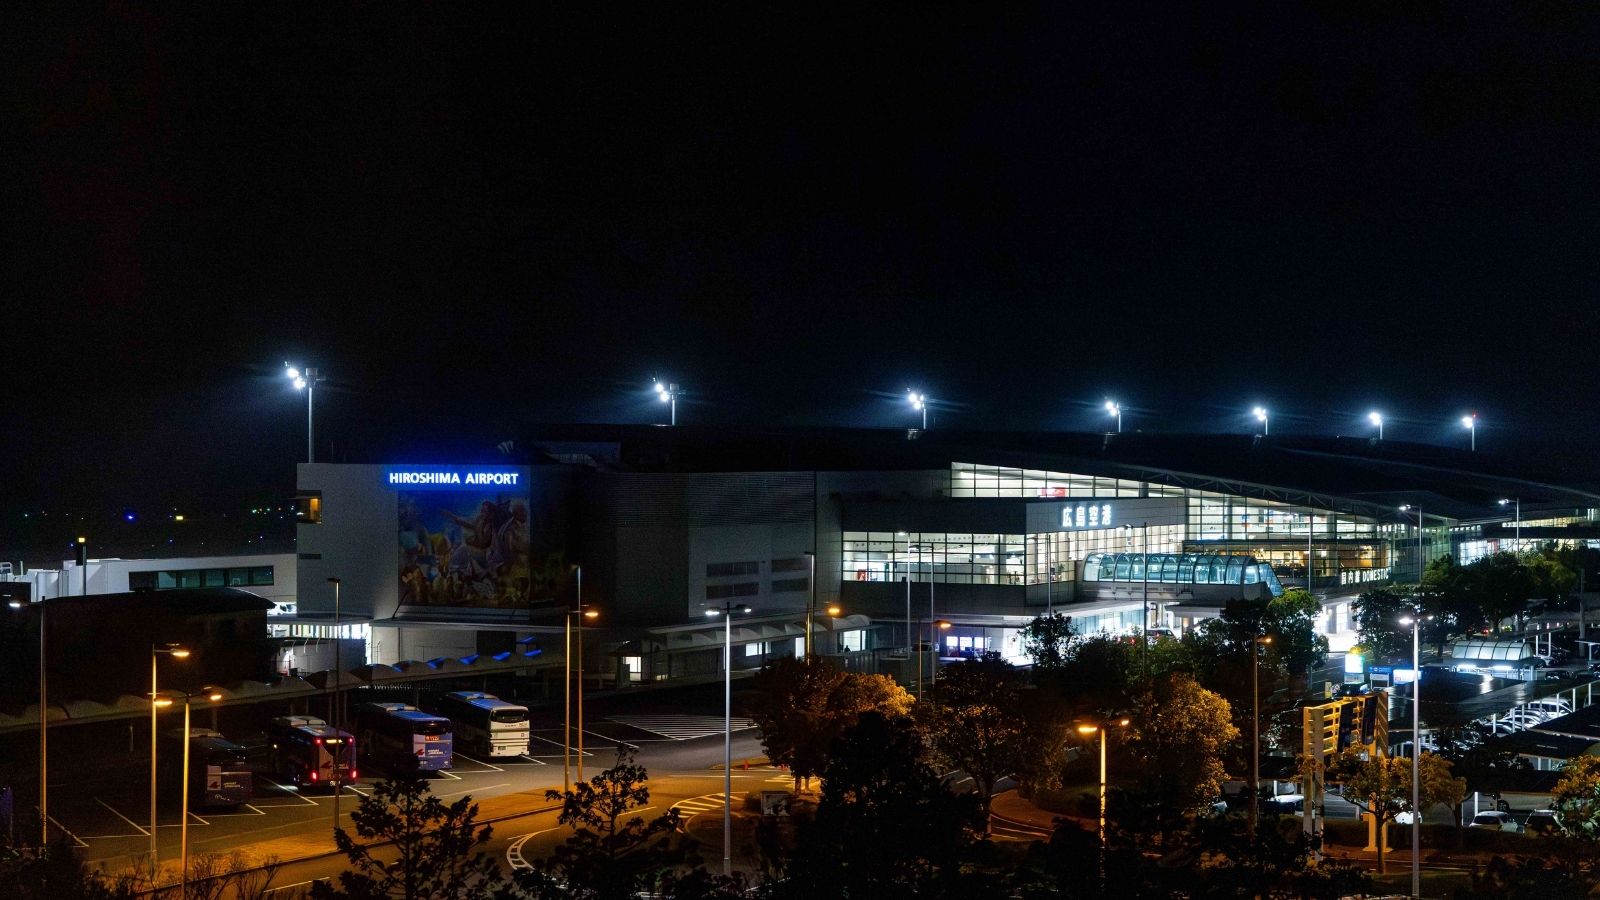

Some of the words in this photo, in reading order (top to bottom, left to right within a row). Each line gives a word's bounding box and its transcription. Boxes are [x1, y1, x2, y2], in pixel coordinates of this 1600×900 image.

[389, 472, 460, 484] HIROSHIMA
[465, 473, 519, 485] AIRPORT
[1062, 504, 1111, 527] 広島空港
[1362, 568, 1389, 583] DOMESTIC
